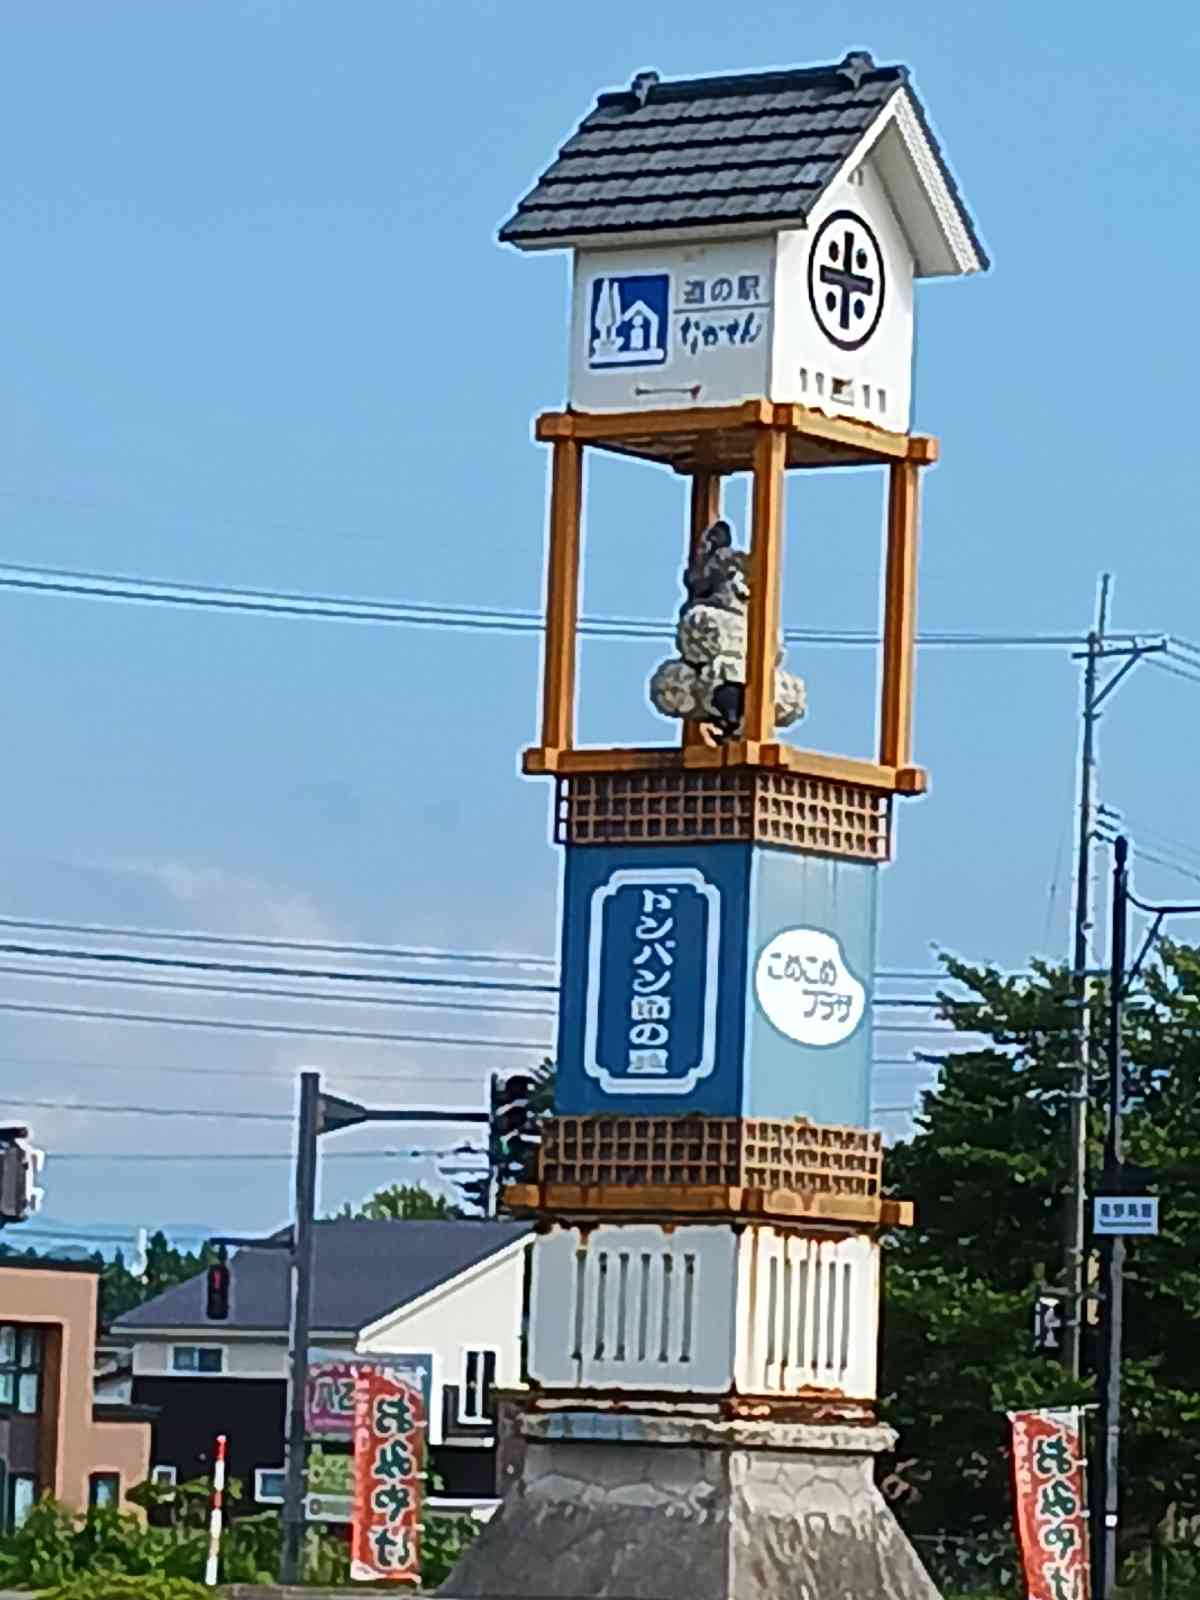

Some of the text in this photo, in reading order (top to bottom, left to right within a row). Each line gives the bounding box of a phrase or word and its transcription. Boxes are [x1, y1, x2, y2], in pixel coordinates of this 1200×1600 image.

[683, 275, 760, 304] 道の駅
[767, 951, 838, 987] こめこめ
